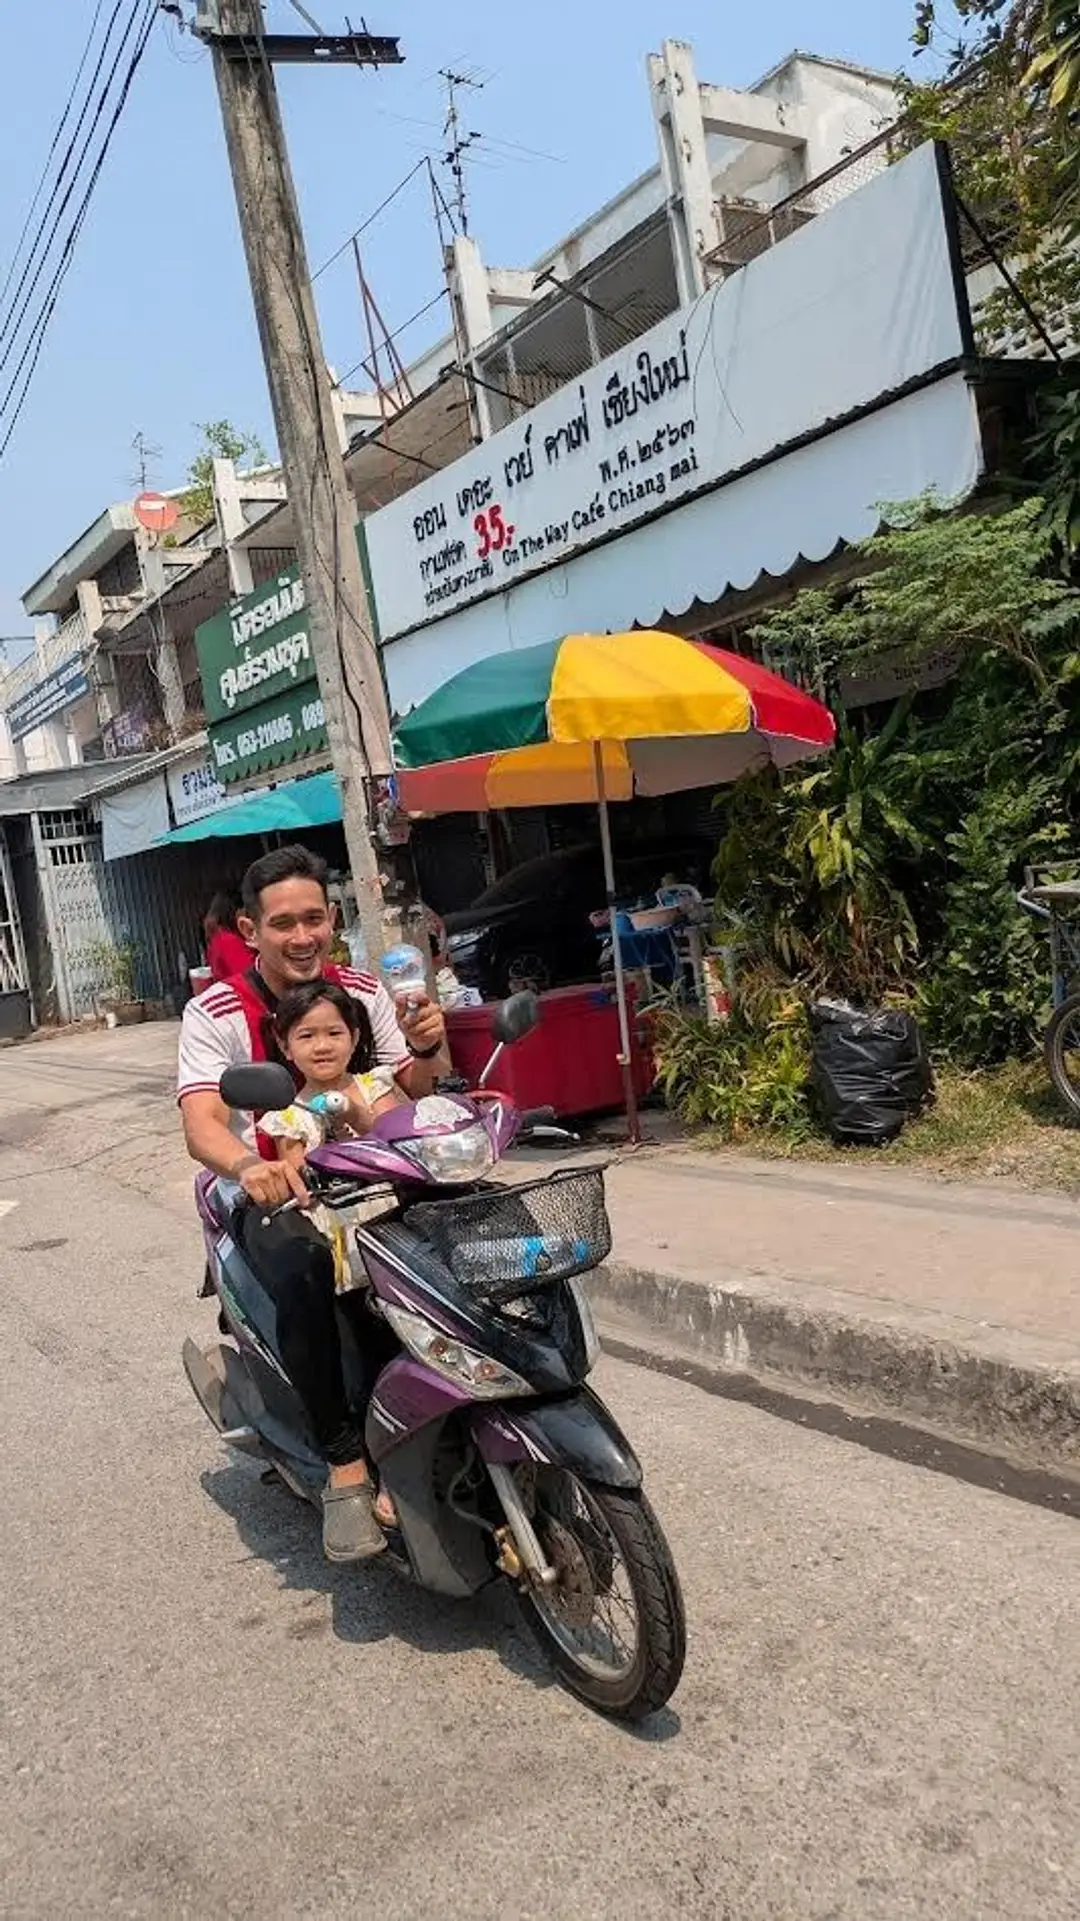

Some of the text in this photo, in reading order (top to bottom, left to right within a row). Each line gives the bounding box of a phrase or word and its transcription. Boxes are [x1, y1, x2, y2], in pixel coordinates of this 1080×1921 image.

[602, 330, 691, 429] เชียงใหม่
[502, 549, 520, 567] On
[519, 536, 544, 559] The
[544, 521, 570, 546] Way
[607, 472, 667, 512] Chiang
[669, 447, 699, 481] mai
